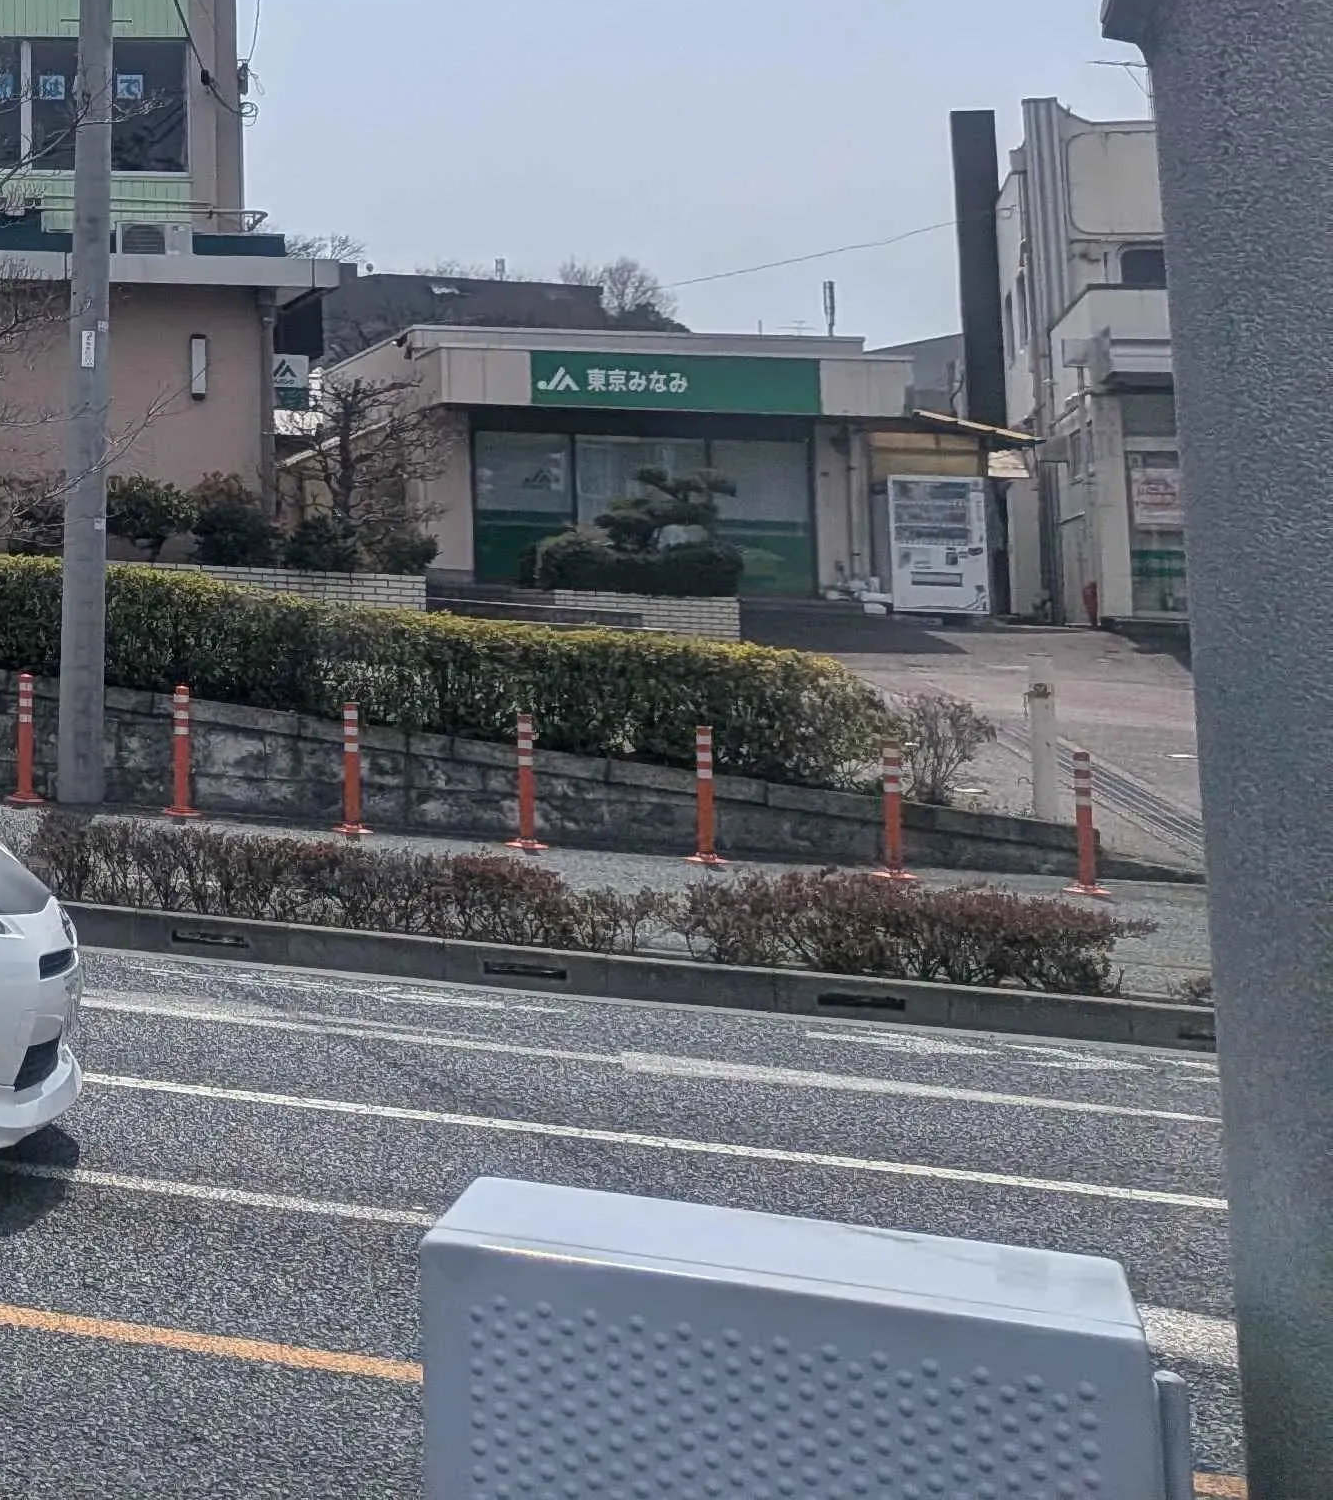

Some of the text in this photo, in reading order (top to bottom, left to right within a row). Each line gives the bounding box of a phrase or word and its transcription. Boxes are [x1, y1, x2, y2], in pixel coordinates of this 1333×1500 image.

[586, 369, 688, 393] 東京みなみ
